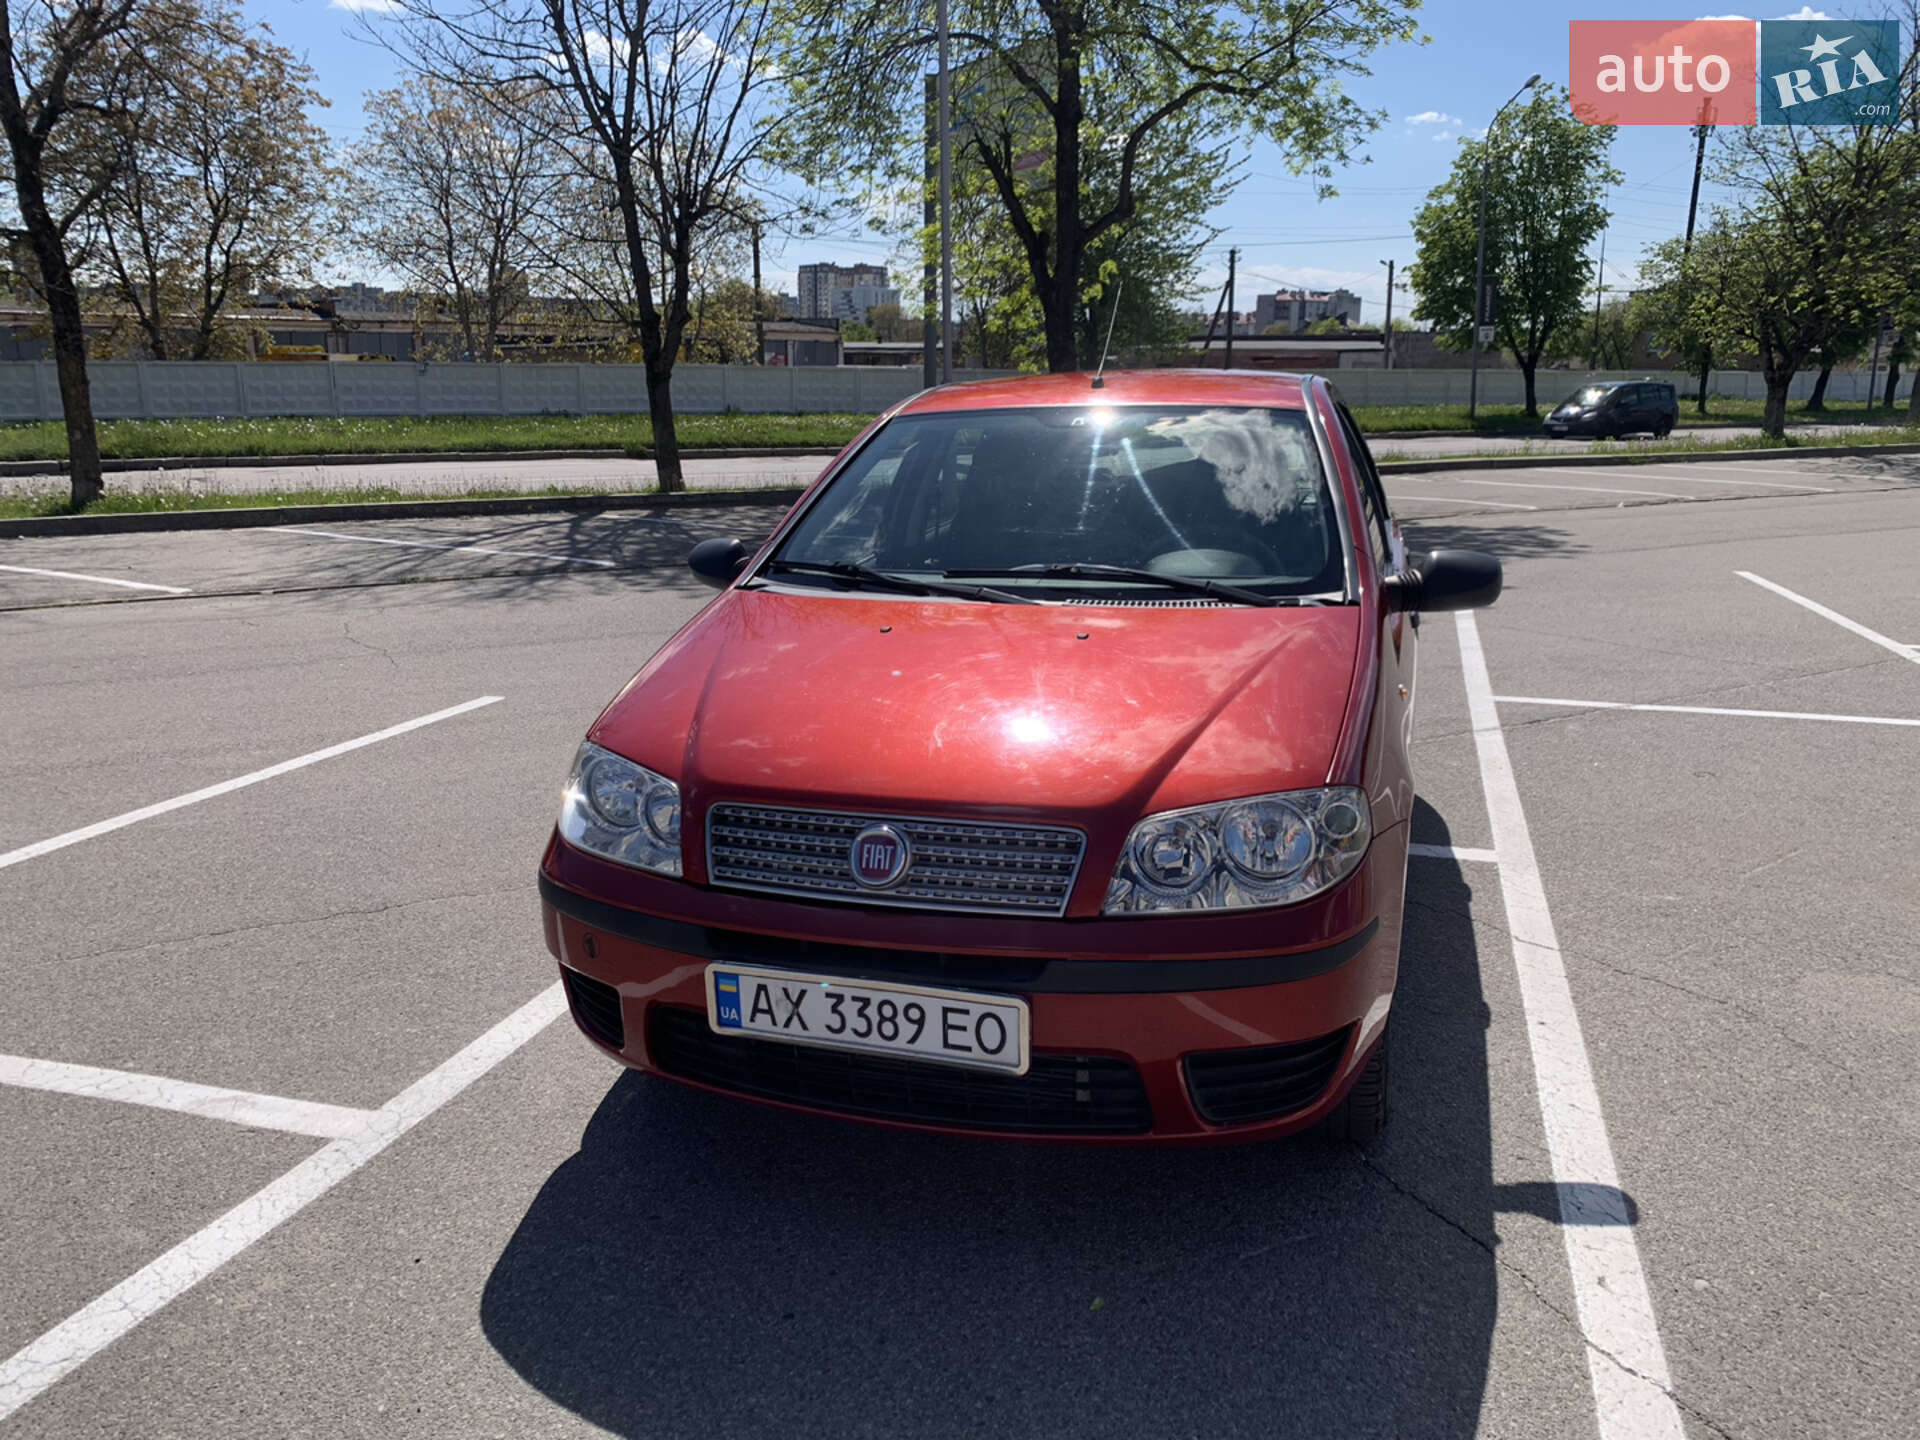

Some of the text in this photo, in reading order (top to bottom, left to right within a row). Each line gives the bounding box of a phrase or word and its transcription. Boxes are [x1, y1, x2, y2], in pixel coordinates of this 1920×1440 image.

[862, 843, 895, 870] FIAT
[720, 1006, 740, 1021] UA
[749, 983, 1008, 1056] AX 3389 EO
